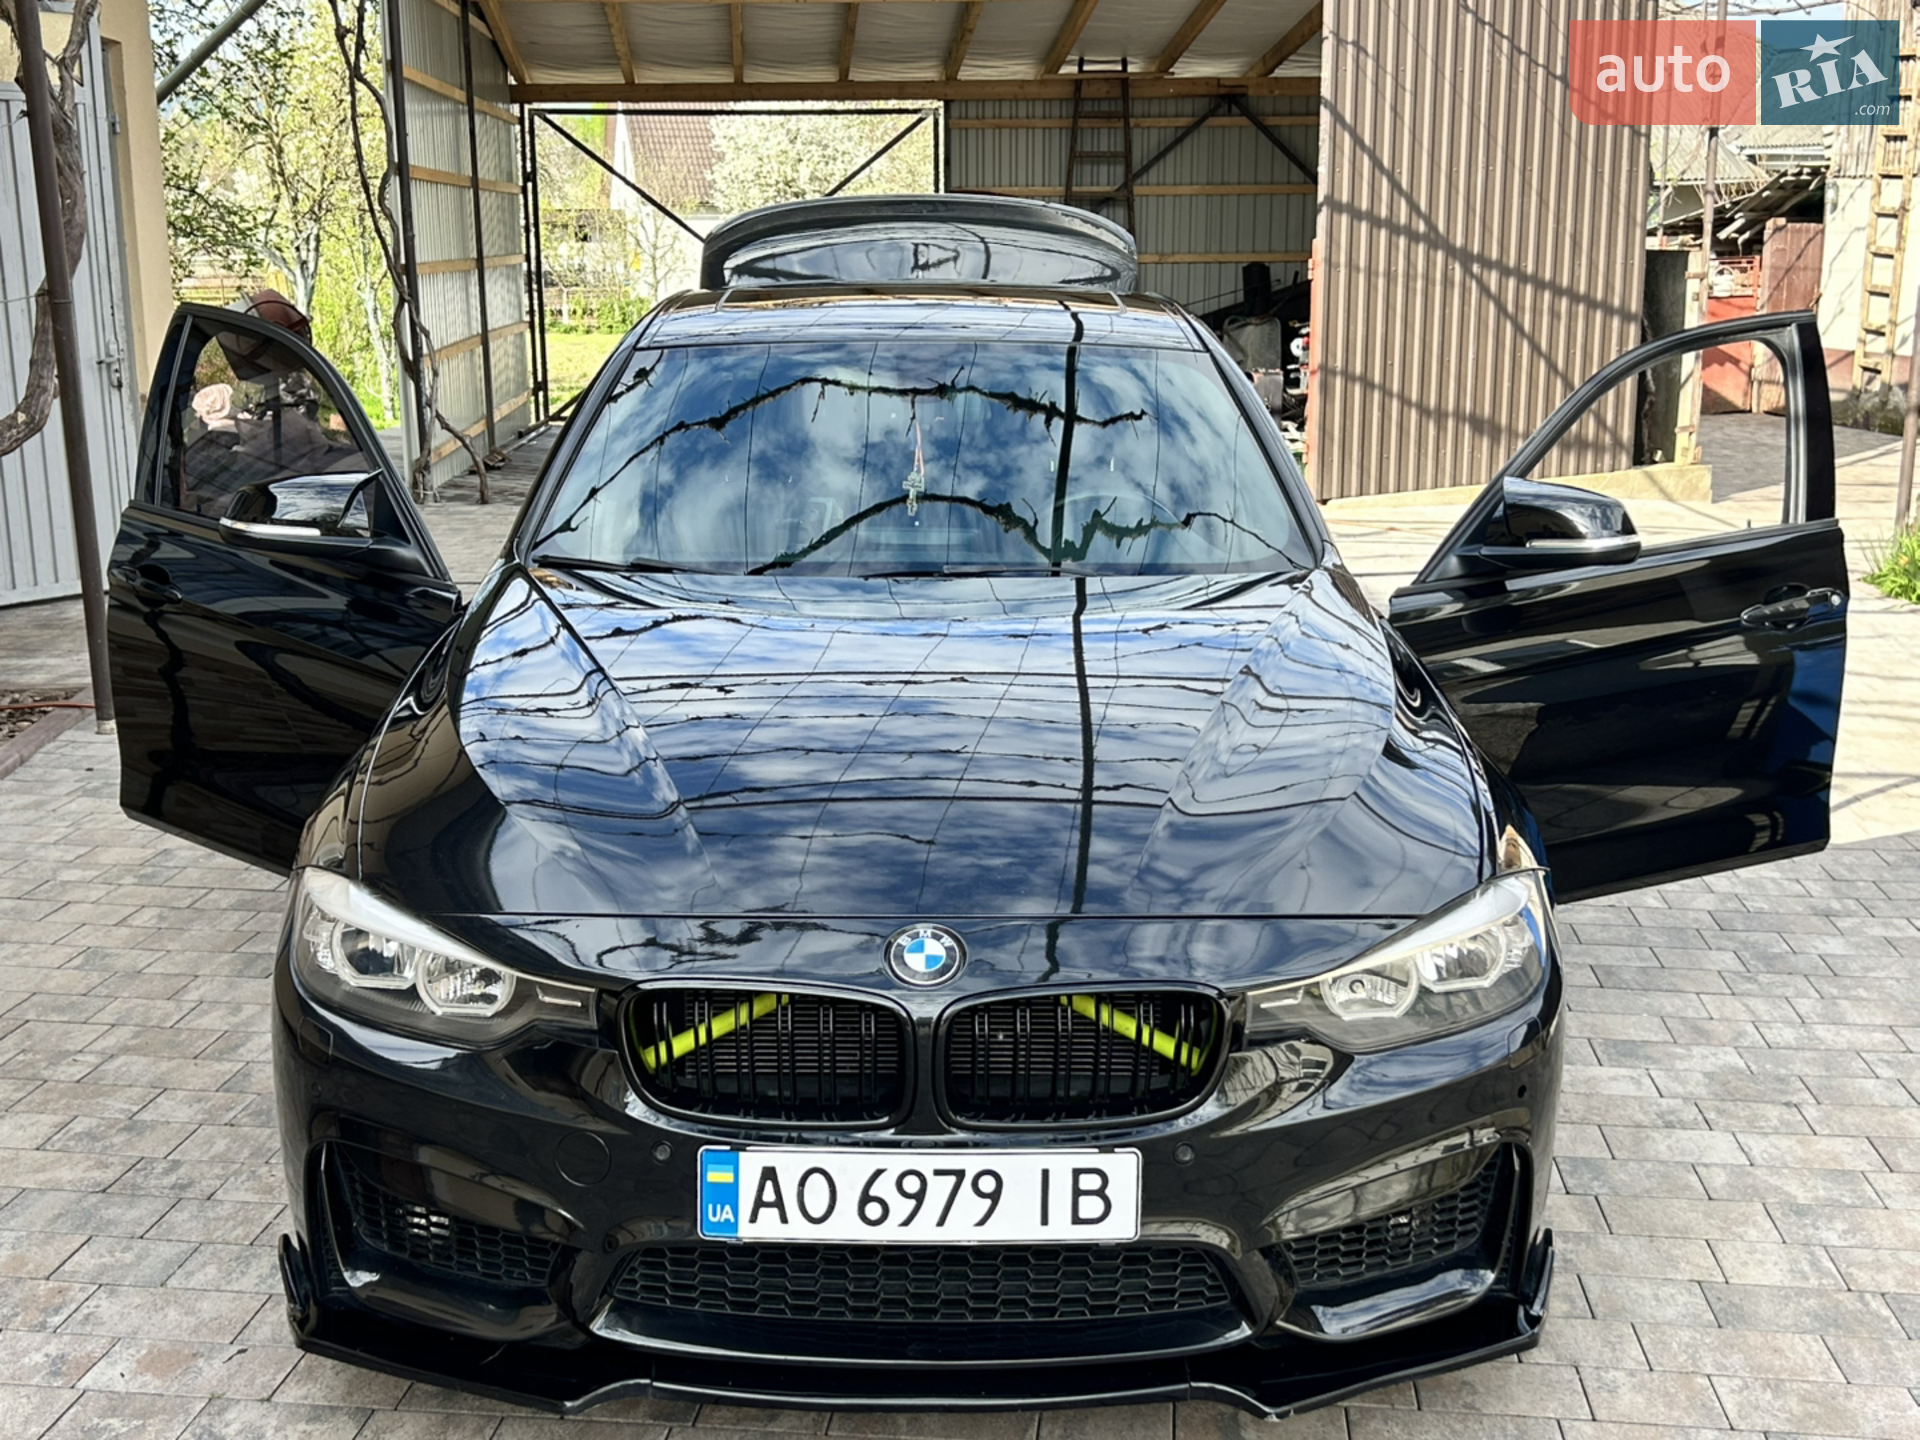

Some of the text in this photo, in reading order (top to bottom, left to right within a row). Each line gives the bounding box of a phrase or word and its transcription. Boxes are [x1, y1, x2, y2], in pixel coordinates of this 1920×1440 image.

[898, 928, 954, 947] BMW
[748, 1165, 1113, 1228] AO 6979 IB
[707, 1203, 736, 1223] UA
